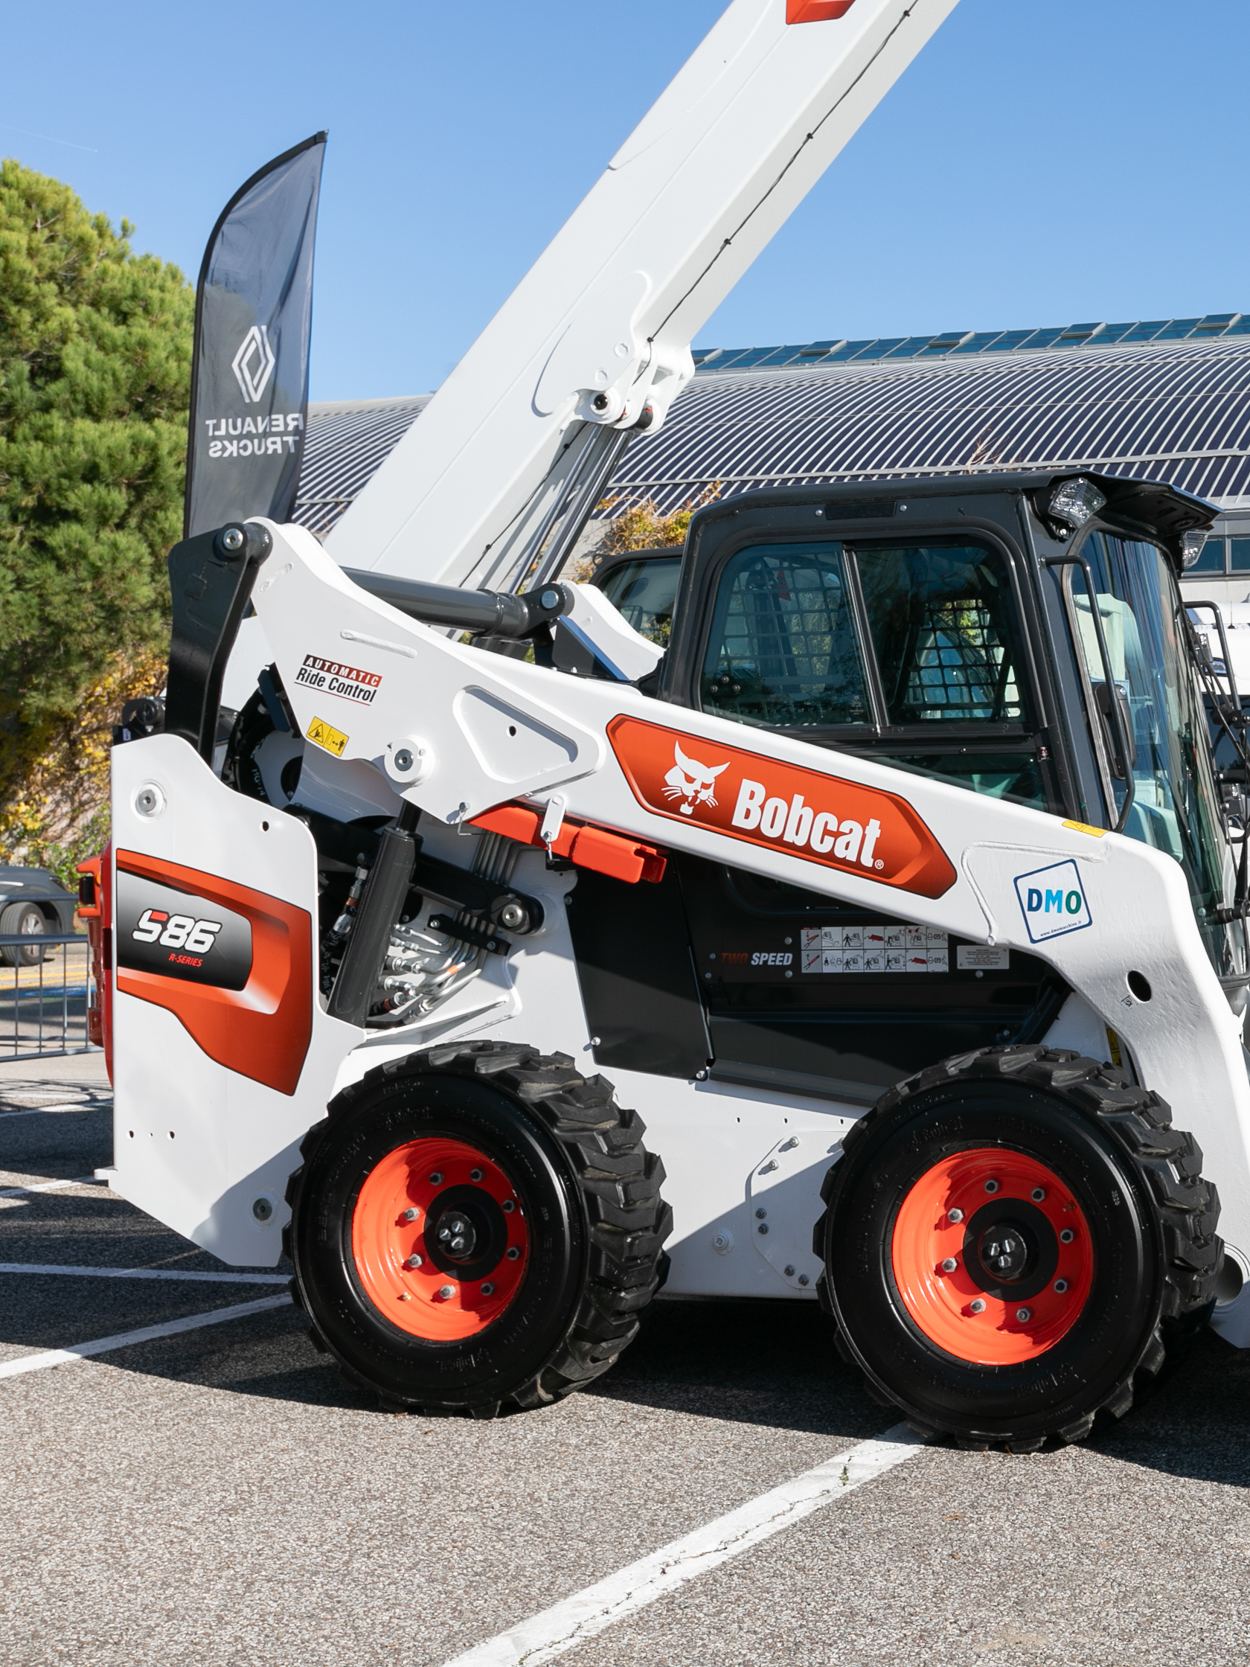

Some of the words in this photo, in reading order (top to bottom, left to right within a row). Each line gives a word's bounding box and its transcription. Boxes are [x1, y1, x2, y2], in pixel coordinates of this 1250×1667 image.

[296, 667, 326, 688] Ride
[328, 677, 377, 703] Control
[306, 656, 379, 687] AUTOMATIC
[1027, 888, 1082, 914] DMO
[132, 908, 222, 954] S86
[168, 953, 203, 967] R-SERIES
[721, 952, 748, 965] TWO
[750, 952, 793, 966] SPEED
